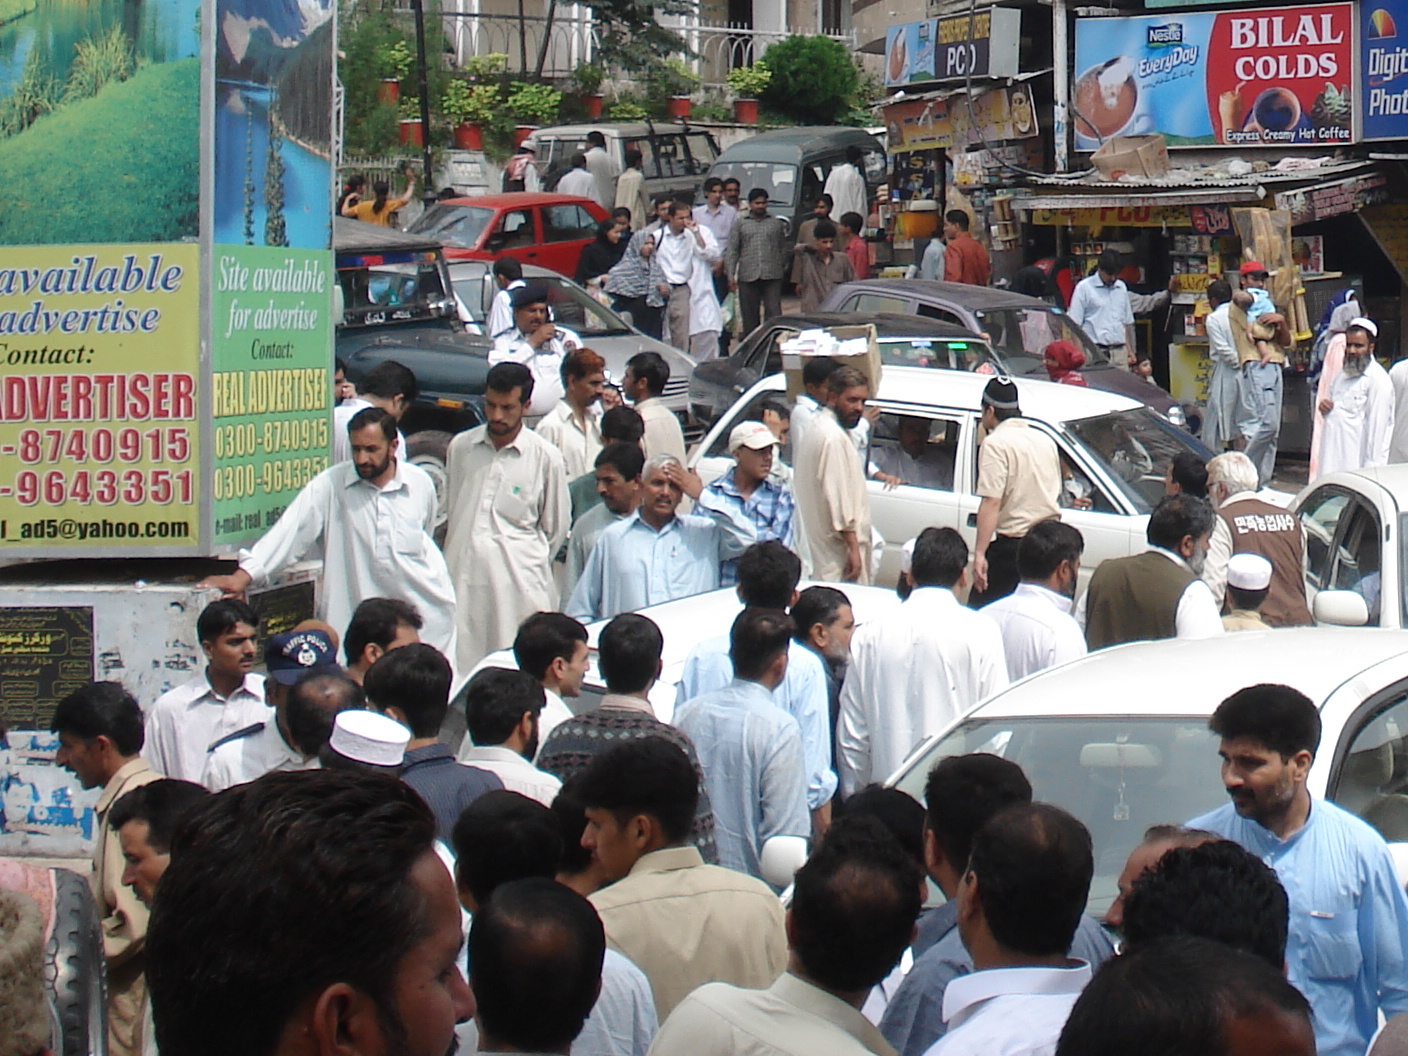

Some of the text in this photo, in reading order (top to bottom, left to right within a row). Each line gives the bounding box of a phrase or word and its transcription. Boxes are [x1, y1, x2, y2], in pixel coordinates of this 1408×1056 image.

[1230, 13, 1344, 49] BILAL
[1138, 45, 1200, 78] EveryDay
[1235, 52, 1338, 81] COLDS
[1226, 129, 1261, 143] Express
[1263, 128, 1297, 143] Creamy
[1318, 126, 1351, 140] Coffee
[218, 256, 326, 294] Site available
[0, 301, 161, 334] advertise
[226, 299, 318, 339] for advertise
[0, 345, 95, 365] ontact:
[251, 339, 294, 361] Contact:
[213, 372, 247, 417] REAL
[215, 418, 328, 458] 0300-8740915
[282, 634, 328, 656] TRAFFIC POLICE
